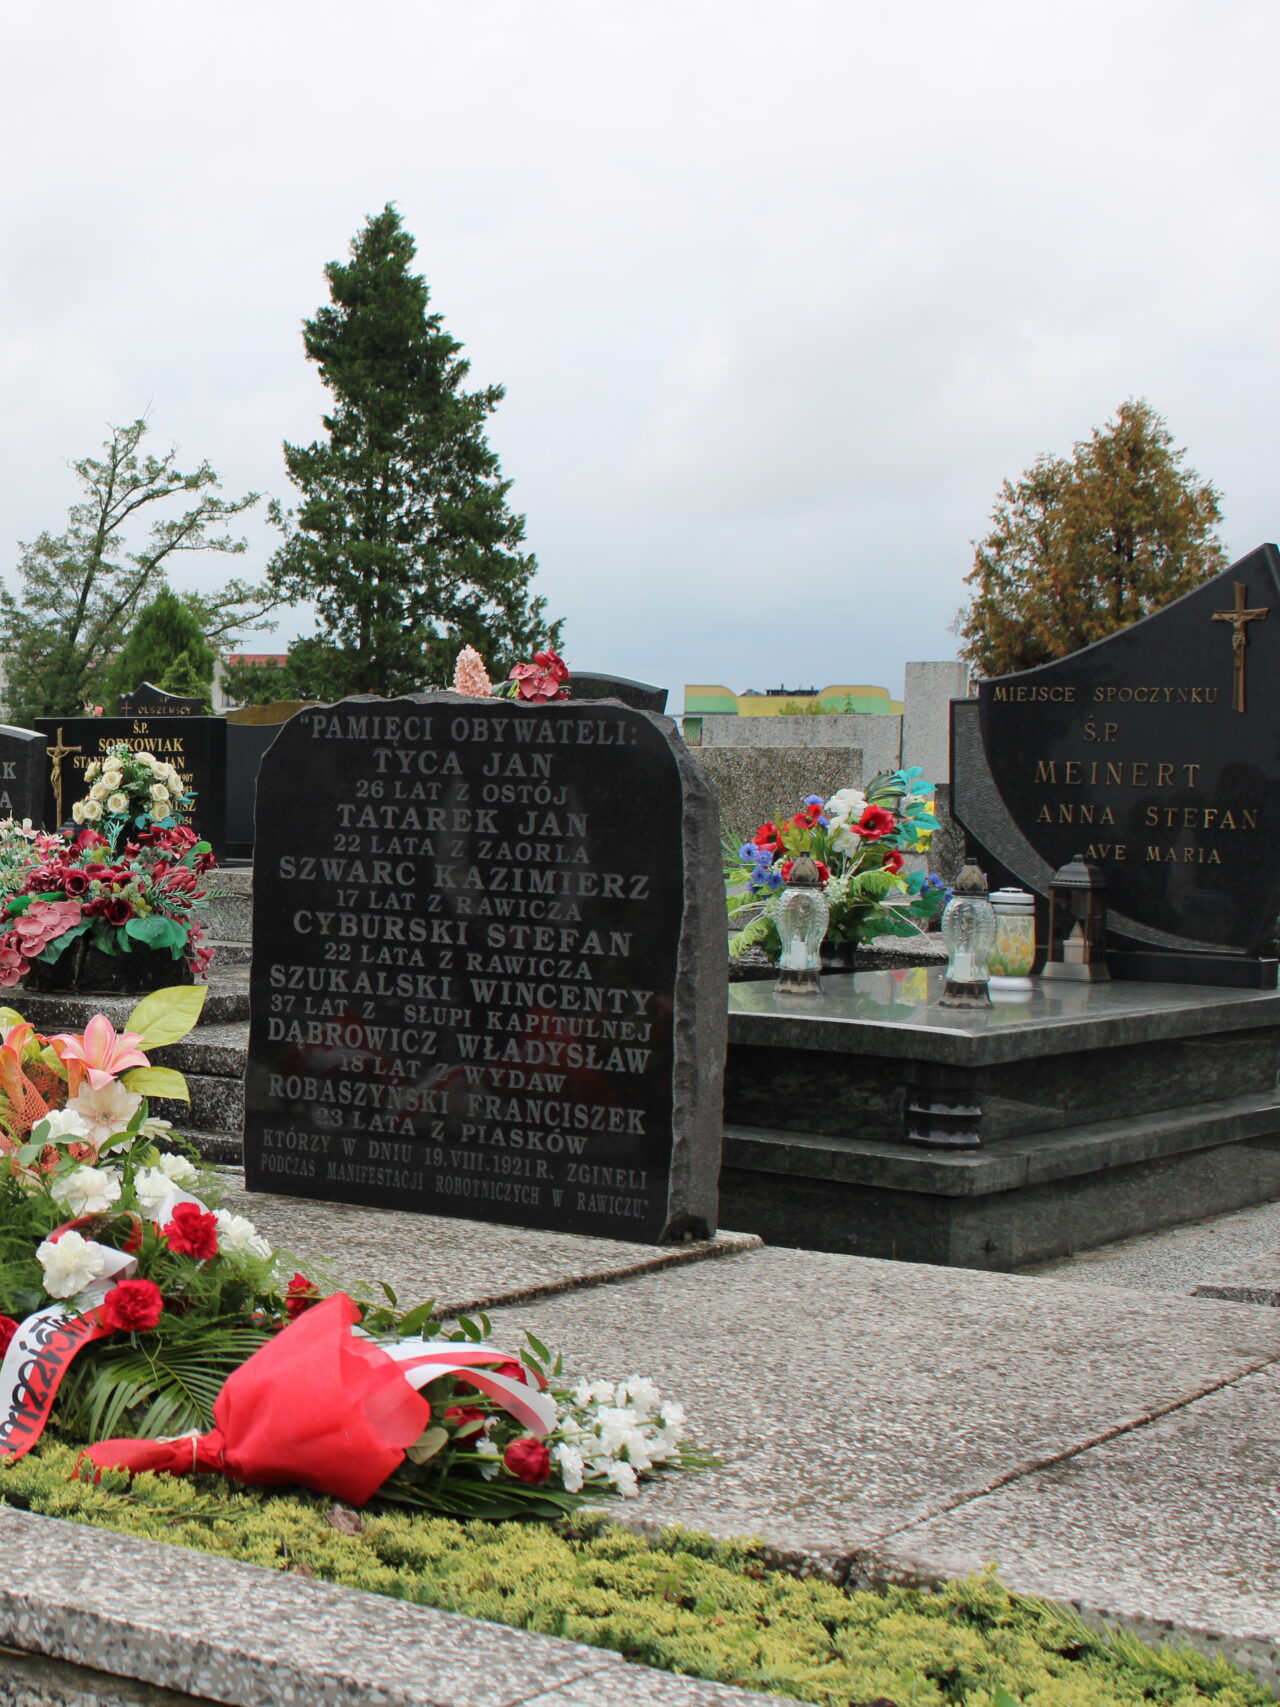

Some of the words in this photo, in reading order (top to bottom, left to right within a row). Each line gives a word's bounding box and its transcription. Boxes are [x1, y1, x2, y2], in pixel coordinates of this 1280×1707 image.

[993, 686, 1076, 703] MIEJSCE
[1093, 686, 1218, 704] SPOCZYNKU
[450, 717, 639, 746] OBYWATELI:
[1083, 714, 1119, 742] Ś.P.
[372, 747, 464, 776] TYCA
[482, 752, 553, 779] JAN
[1034, 760, 1200, 788] MEINERT
[356, 779, 385, 799] 26
[394, 781, 442, 800] LAT
[455, 783, 470, 801] Z
[481, 779, 569, 806] OSTÓJ
[335, 803, 499, 835] TATAREK
[517, 810, 590, 838] JAN
[1036, 804, 1117, 825] ANNA
[1145, 806, 1259, 830] STEFAN
[333, 835, 361, 852] 22
[370, 836, 436, 857] LATA
[450, 839, 465, 857] Z
[477, 840, 591, 864] ZAORLA
[1086, 844, 1127, 861] AVE
[1146, 846, 1222, 864] MARIA
[279, 855, 417, 886] SZWARC
[434, 864, 651, 900] KAZIMIERZ
[336, 889, 359, 907] 17
[368, 891, 415, 911] LAT
[427, 894, 443, 913] Z
[455, 896, 584, 922] RAWICZA
[293, 909, 469, 946] CYBURSKI
[486, 922, 633, 958] STEFAN
[323, 942, 352, 961] 22
[360, 944, 426, 967] LATA
[439, 950, 454, 969] Z
[466, 952, 593, 980] RAWICZA
[269, 964, 452, 1000] SZUKALSKI
[470, 978, 654, 1016] WINCENTY
[270, 995, 298, 1014] 37
[304, 996, 349, 1018] LAT
[362, 1001, 377, 1020] Z
[403, 1004, 473, 1029] SŁUPI
[486, 1012, 653, 1042] KAPITULNEJ
[267, 1017, 438, 1056] DĄBROWICZ
[456, 1033, 653, 1075] WŁADYSŁAW
[339, 1053, 365, 1073] 18
[373, 1056, 422, 1079] LAT
[434, 1062, 450, 1082] Z
[463, 1065, 568, 1094] WYDAW
[267, 1072, 450, 1116] ROBASZYŃSKI
[467, 1094, 647, 1136] FRANCISZEK
[316, 1107, 344, 1128] 23
[352, 1111, 417, 1137] LATA
[430, 1120, 446, 1141] Z
[460, 1121, 589, 1156] PIASKÓW
[261, 1126, 332, 1154] KTÓRZY
[342, 1137, 358, 1157] W
[368, 1140, 413, 1163] DNIU
[566, 1162, 648, 1193] ZGINĘLI
[260, 1153, 317, 1178] PODCZAS
[326, 1161, 424, 1191] MANIFESTACJI
[435, 1176, 540, 1207] ROBOTNICZYCH
[551, 1188, 565, 1208] W
